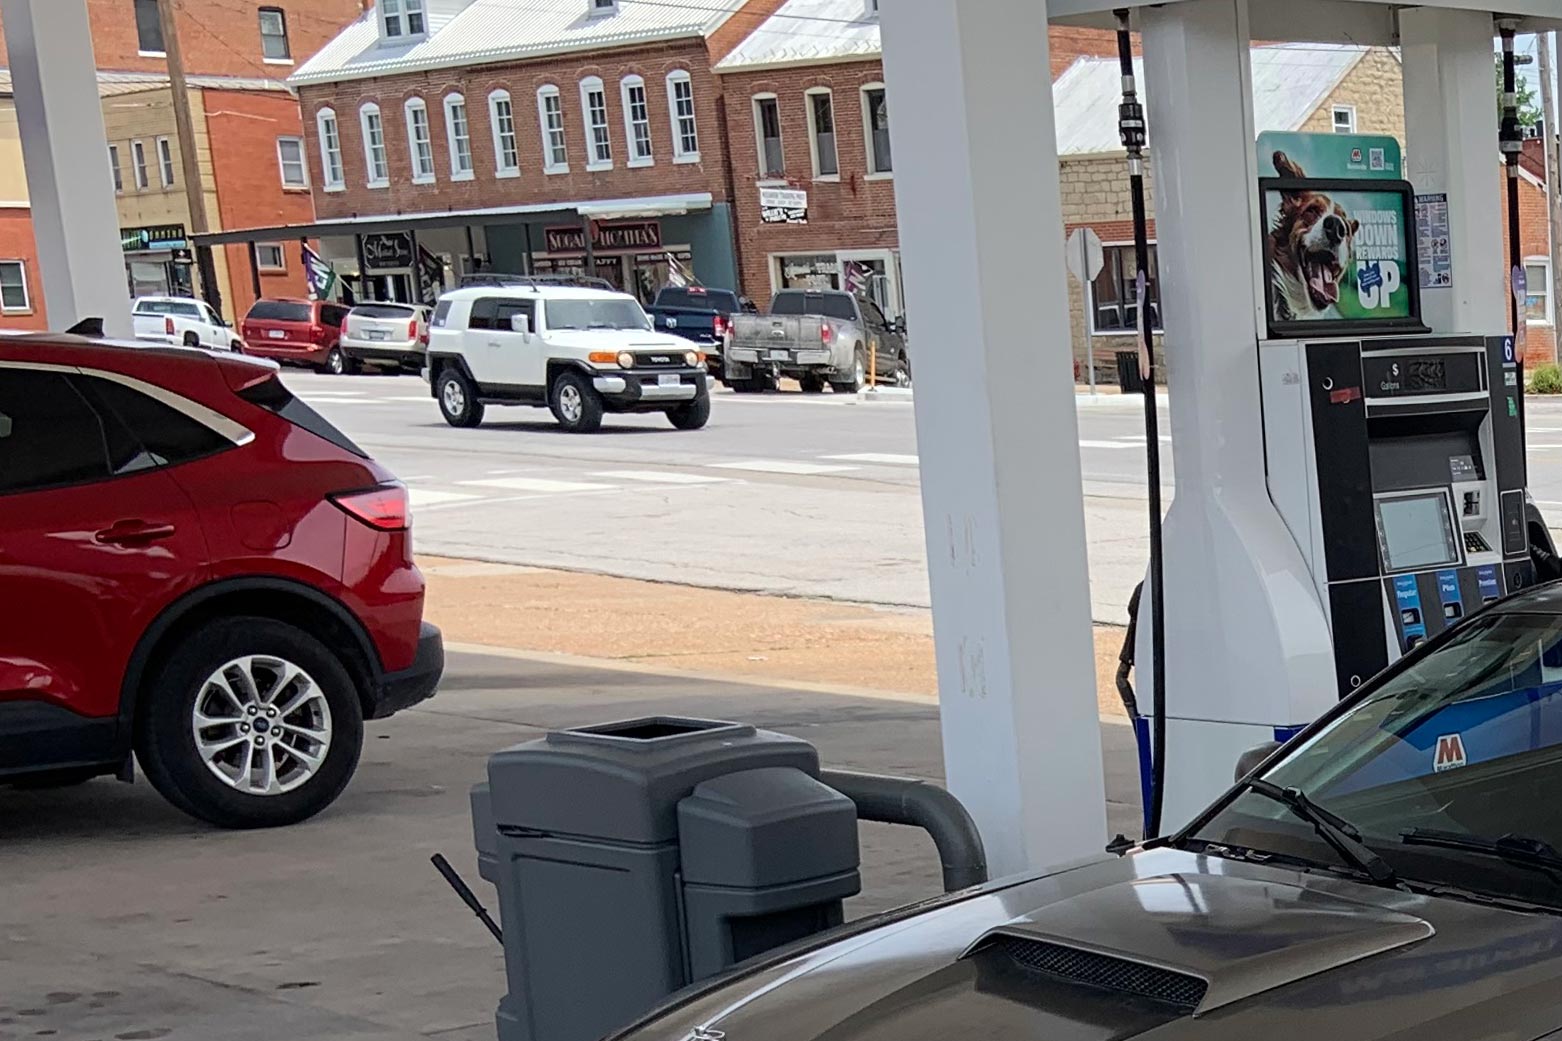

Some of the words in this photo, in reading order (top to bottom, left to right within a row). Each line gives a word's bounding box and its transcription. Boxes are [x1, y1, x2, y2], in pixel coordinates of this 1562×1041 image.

[1354, 210, 1397, 224] WINDOWS
[1355, 224, 1398, 246] DOWN
[1356, 246, 1399, 260] REWARDS
[1357, 260, 1400, 310] UP
[1504, 338, 1512, 361] 6
[1392, 362, 1400, 377] $
[1379, 380, 1400, 391] Gallons
[1442, 584, 1456, 592] Plus
[1437, 736, 1464, 765] M
